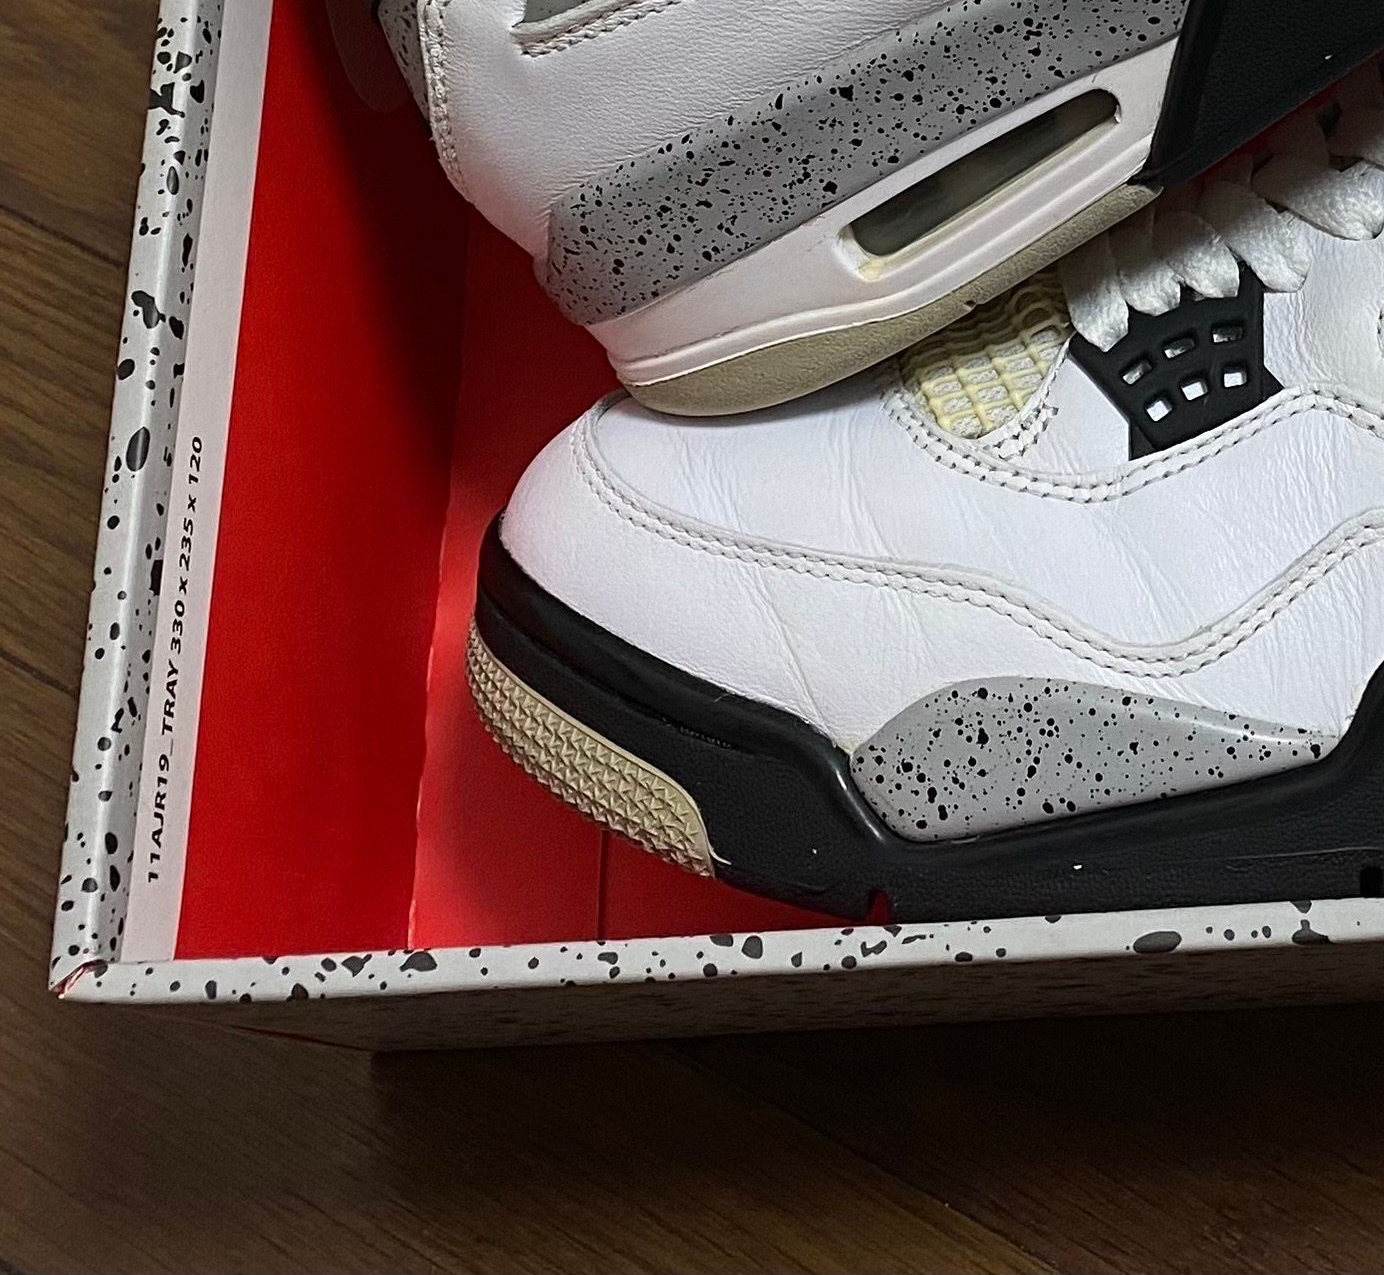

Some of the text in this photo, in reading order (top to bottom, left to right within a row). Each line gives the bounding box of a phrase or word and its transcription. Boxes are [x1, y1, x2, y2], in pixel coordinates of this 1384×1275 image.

[147, 436, 203, 884] 11AJR19_TRAY 330 x 235 x 120
